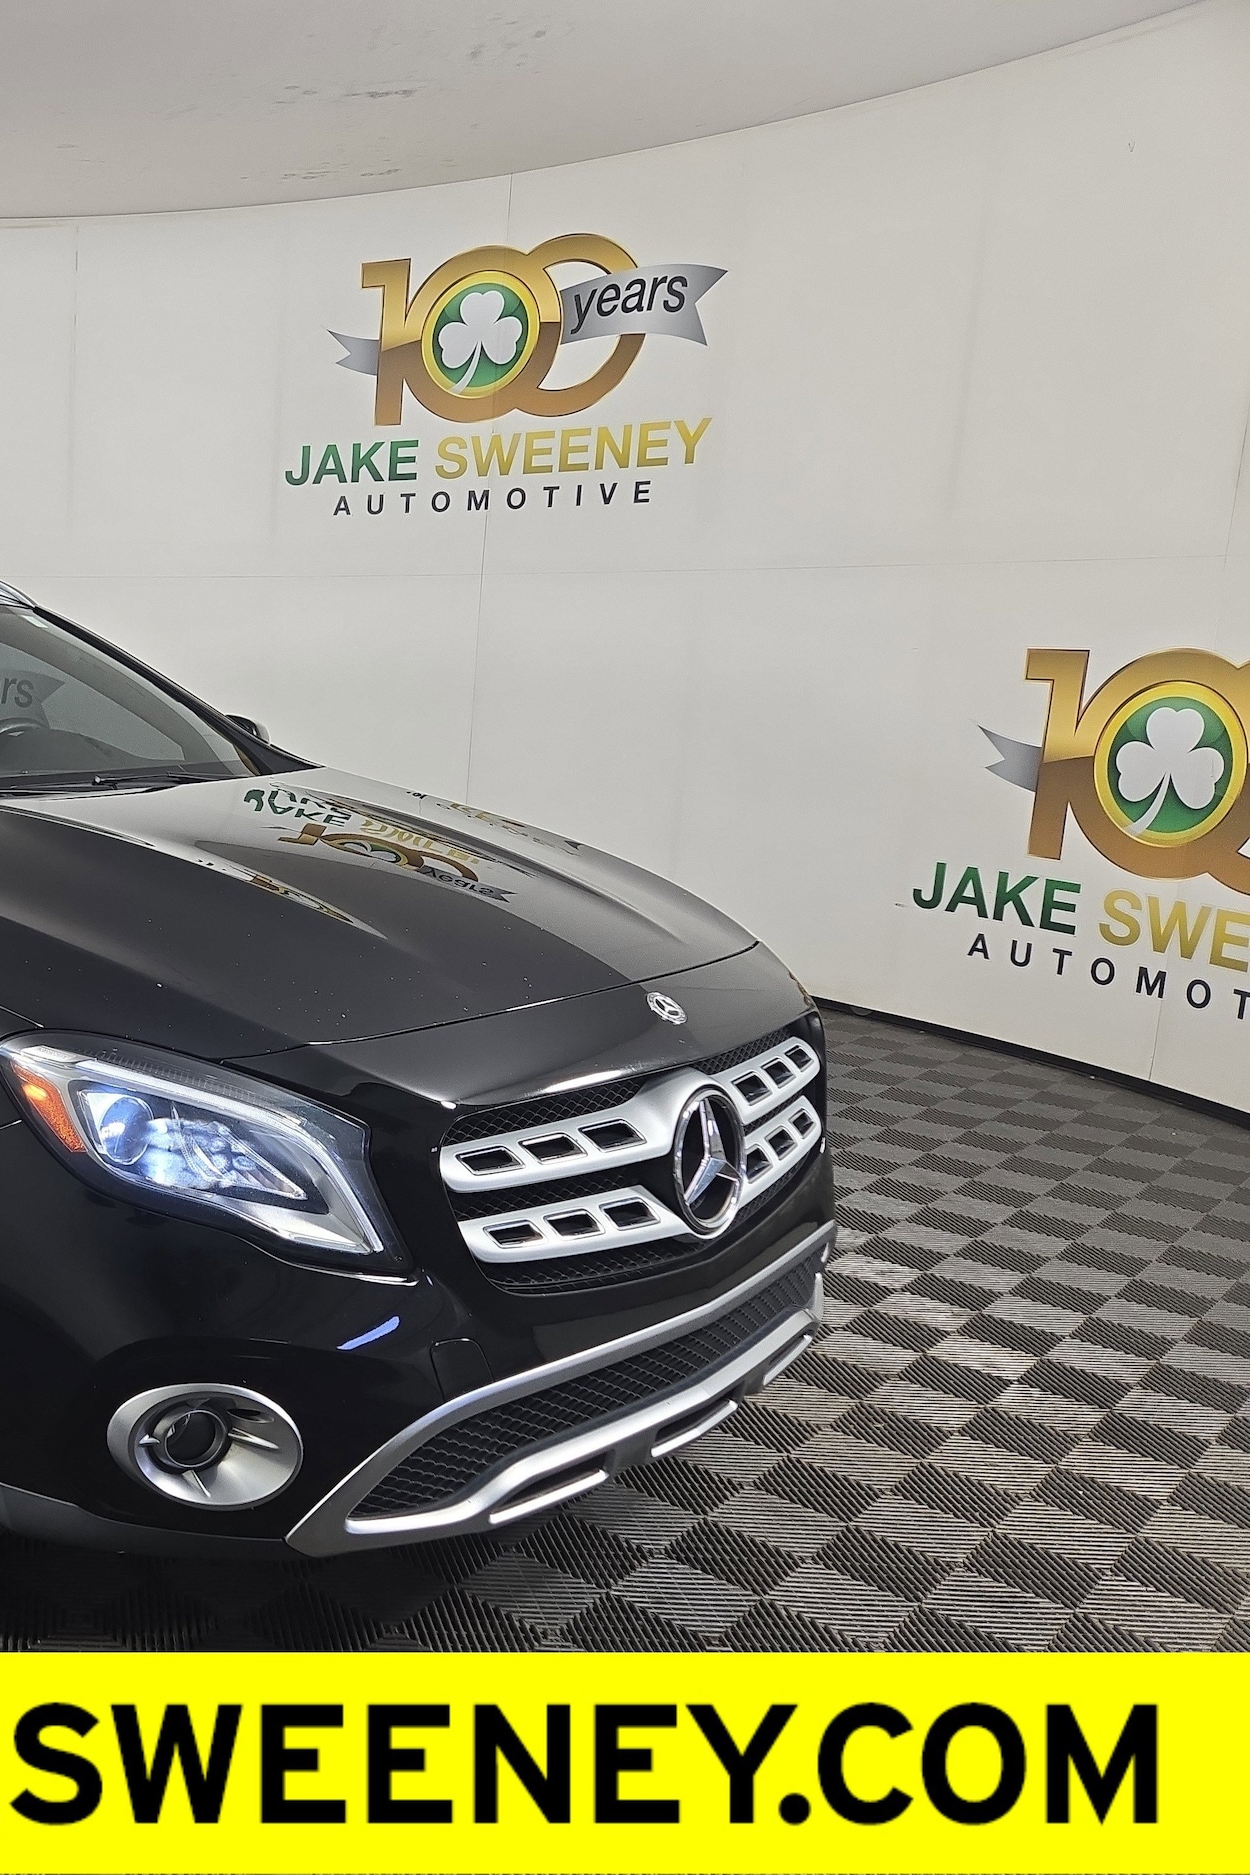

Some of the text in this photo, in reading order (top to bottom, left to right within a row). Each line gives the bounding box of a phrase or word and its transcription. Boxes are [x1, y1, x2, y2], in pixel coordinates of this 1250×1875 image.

[570, 273, 688, 335] years
[285, 417, 713, 486] JAKE SWEENEY
[333, 481, 651, 516] AUTOMOTIVE
[1025, 646, 1250, 896] 10
[912, 862, 1250, 973] JAKE SWE
[967, 933, 1250, 1020] AUTOMOT
